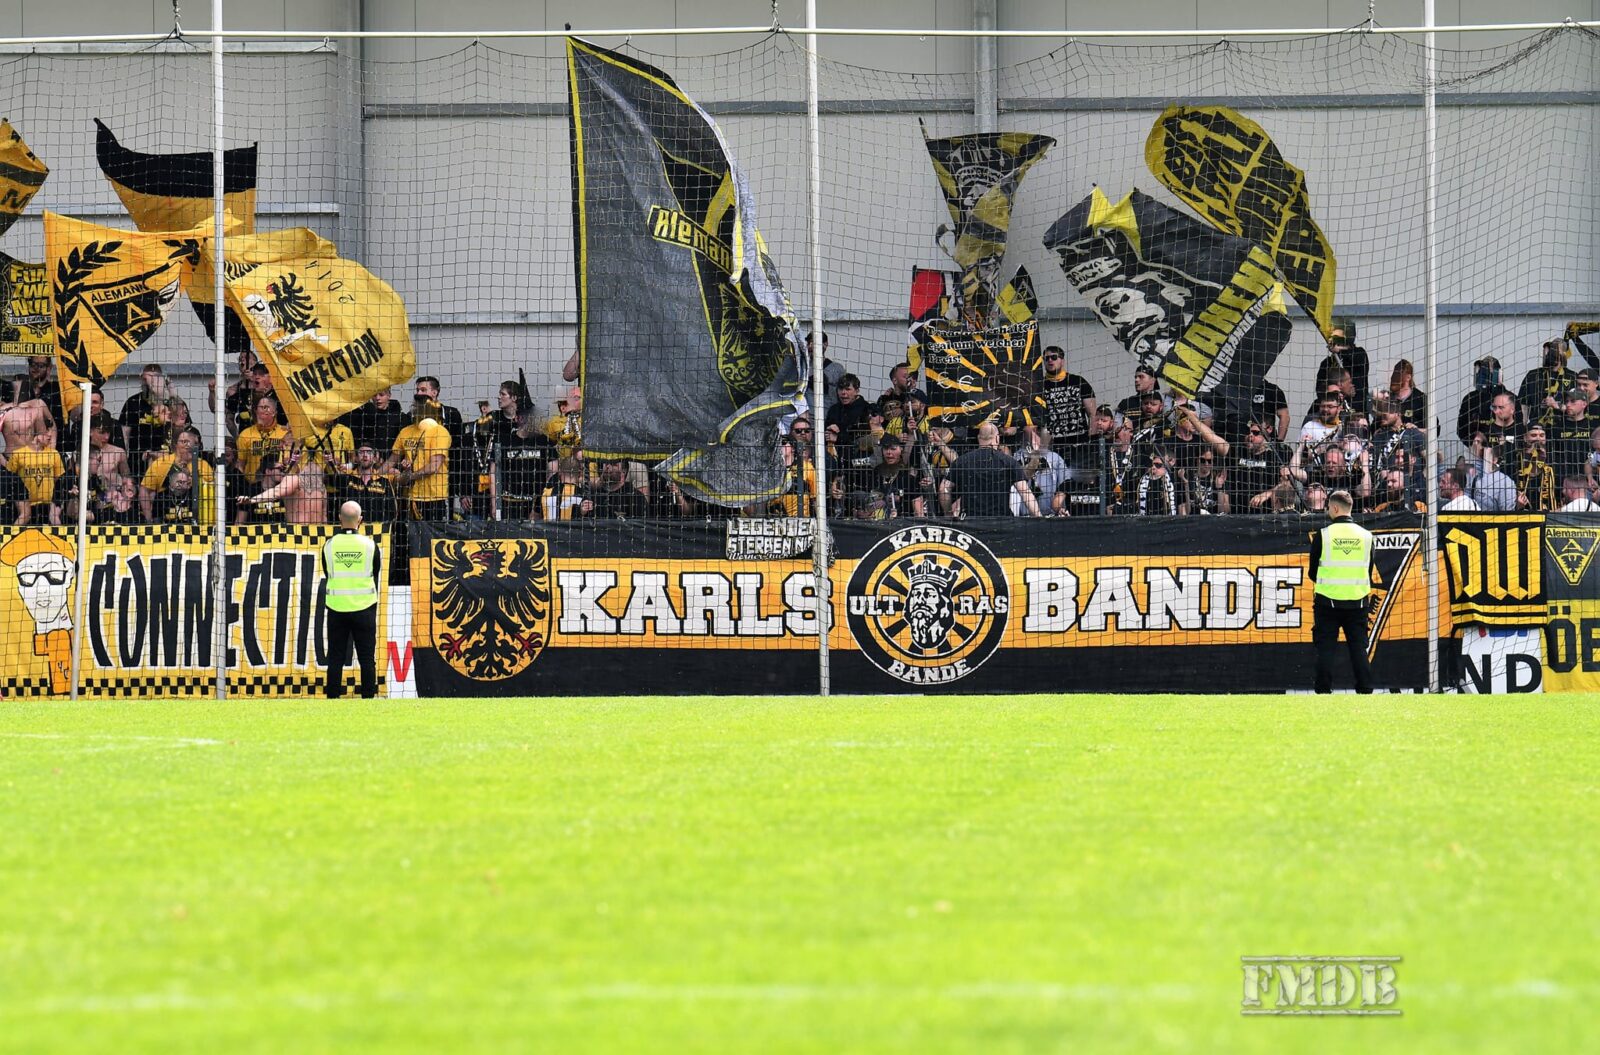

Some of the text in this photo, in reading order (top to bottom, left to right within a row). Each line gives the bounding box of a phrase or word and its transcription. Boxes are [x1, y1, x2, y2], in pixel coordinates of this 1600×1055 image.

[286, 327, 385, 401] NNECTION
[889, 527, 973, 551] KARLS
[558, 571, 836, 637] KARLS
[1022, 566, 1303, 633] BANDE
[887, 659, 972, 684] BANDE
